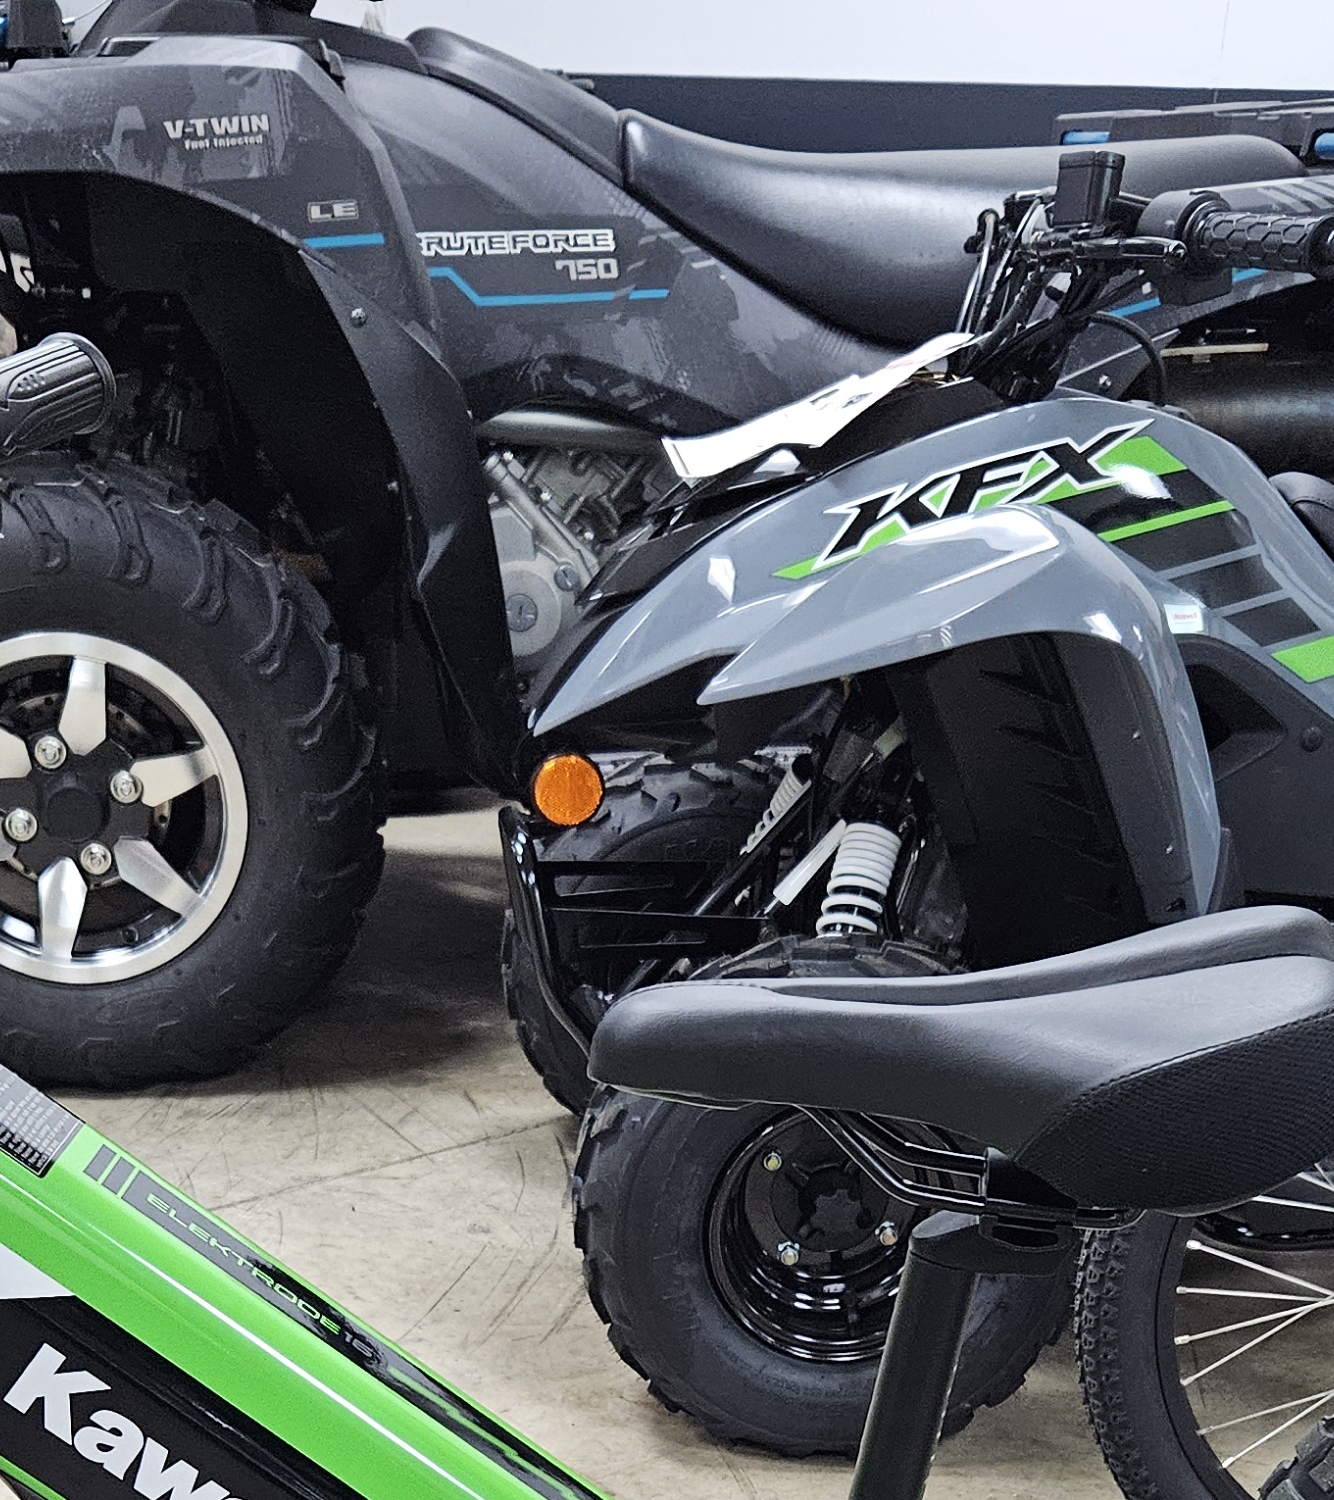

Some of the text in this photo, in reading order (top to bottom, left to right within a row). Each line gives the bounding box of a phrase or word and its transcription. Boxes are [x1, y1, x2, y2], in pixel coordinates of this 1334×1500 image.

[163, 114, 270, 139] V-TWIN
[309, 199, 359, 221] LE
[417, 231, 509, 257] RUTE
[554, 257, 618, 281] 750
[811, 417, 1156, 572] KFX
[146, 1193, 342, 1336] ELEKTRODE
